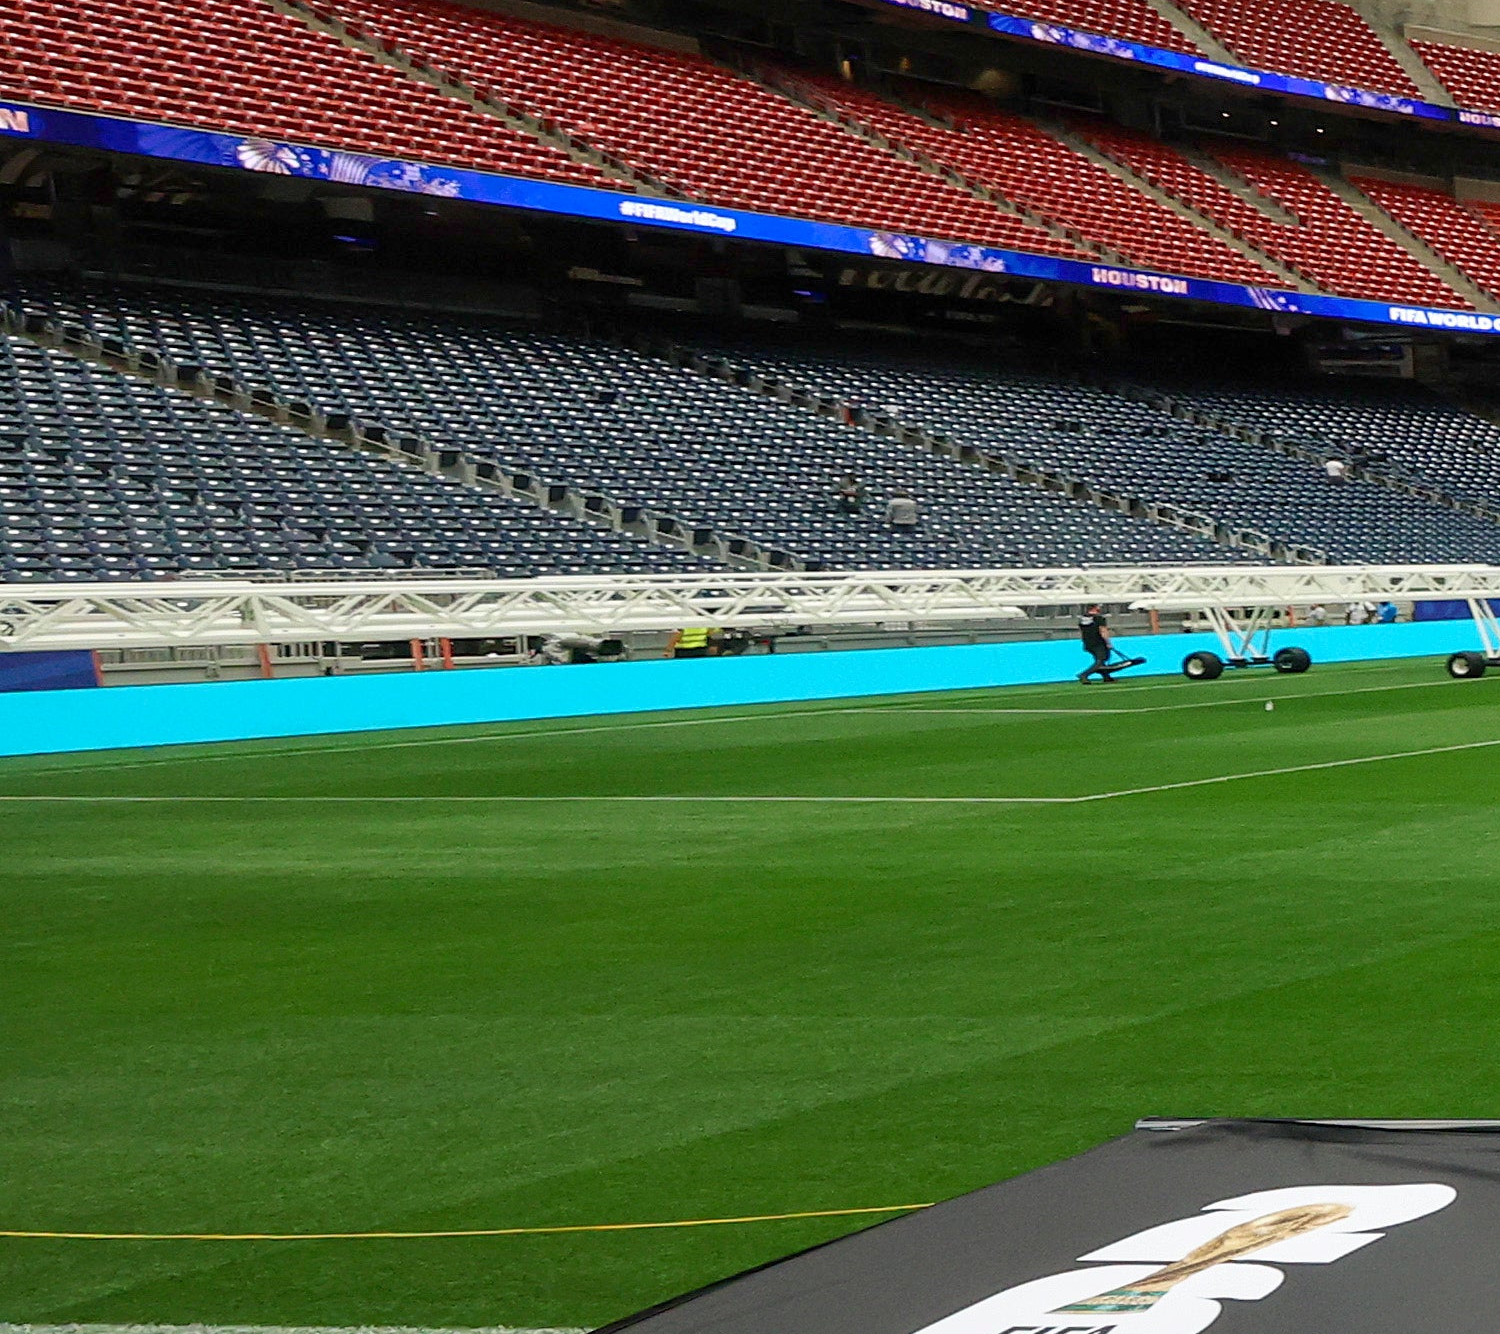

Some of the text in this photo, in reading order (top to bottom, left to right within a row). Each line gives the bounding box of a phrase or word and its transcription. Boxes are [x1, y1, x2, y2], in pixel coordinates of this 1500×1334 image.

[1092, 268, 1188, 294] HOUSTON
[1389, 307, 1428, 324] FIFA
[1428, 312, 1492, 330] WORLD
